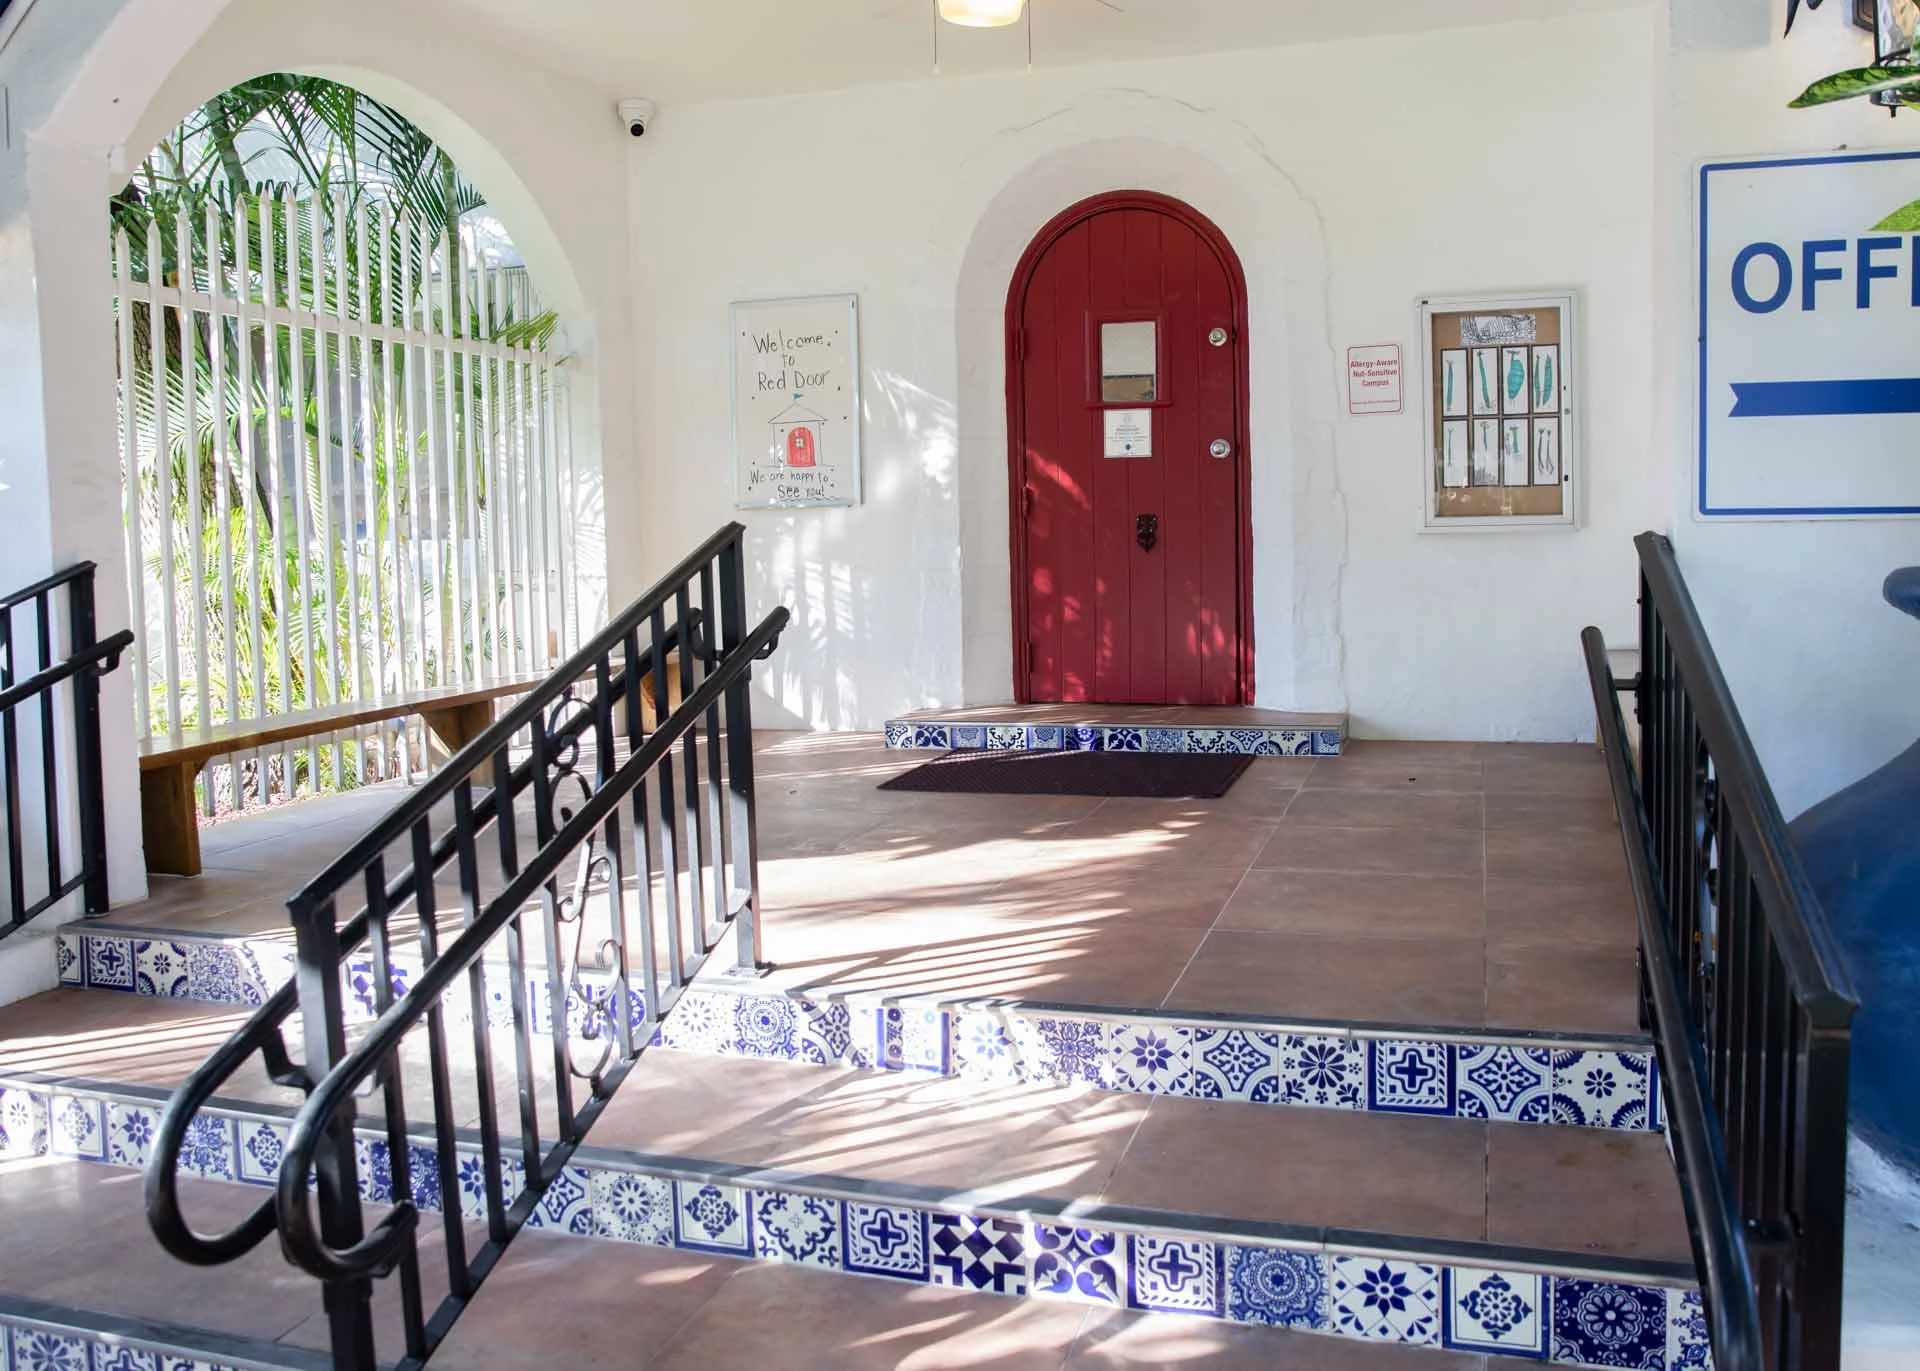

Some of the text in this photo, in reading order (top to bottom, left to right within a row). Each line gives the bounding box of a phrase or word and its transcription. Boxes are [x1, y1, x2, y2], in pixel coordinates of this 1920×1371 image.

[1350, 359, 1398, 368] Allergy-Aware
[1353, 369, 1398, 377] Nut-Sensitive
[758, 370, 831, 392] Red Door
[750, 470, 764, 485] We
[769, 472, 784, 482] are
[790, 471, 814, 483] happy
